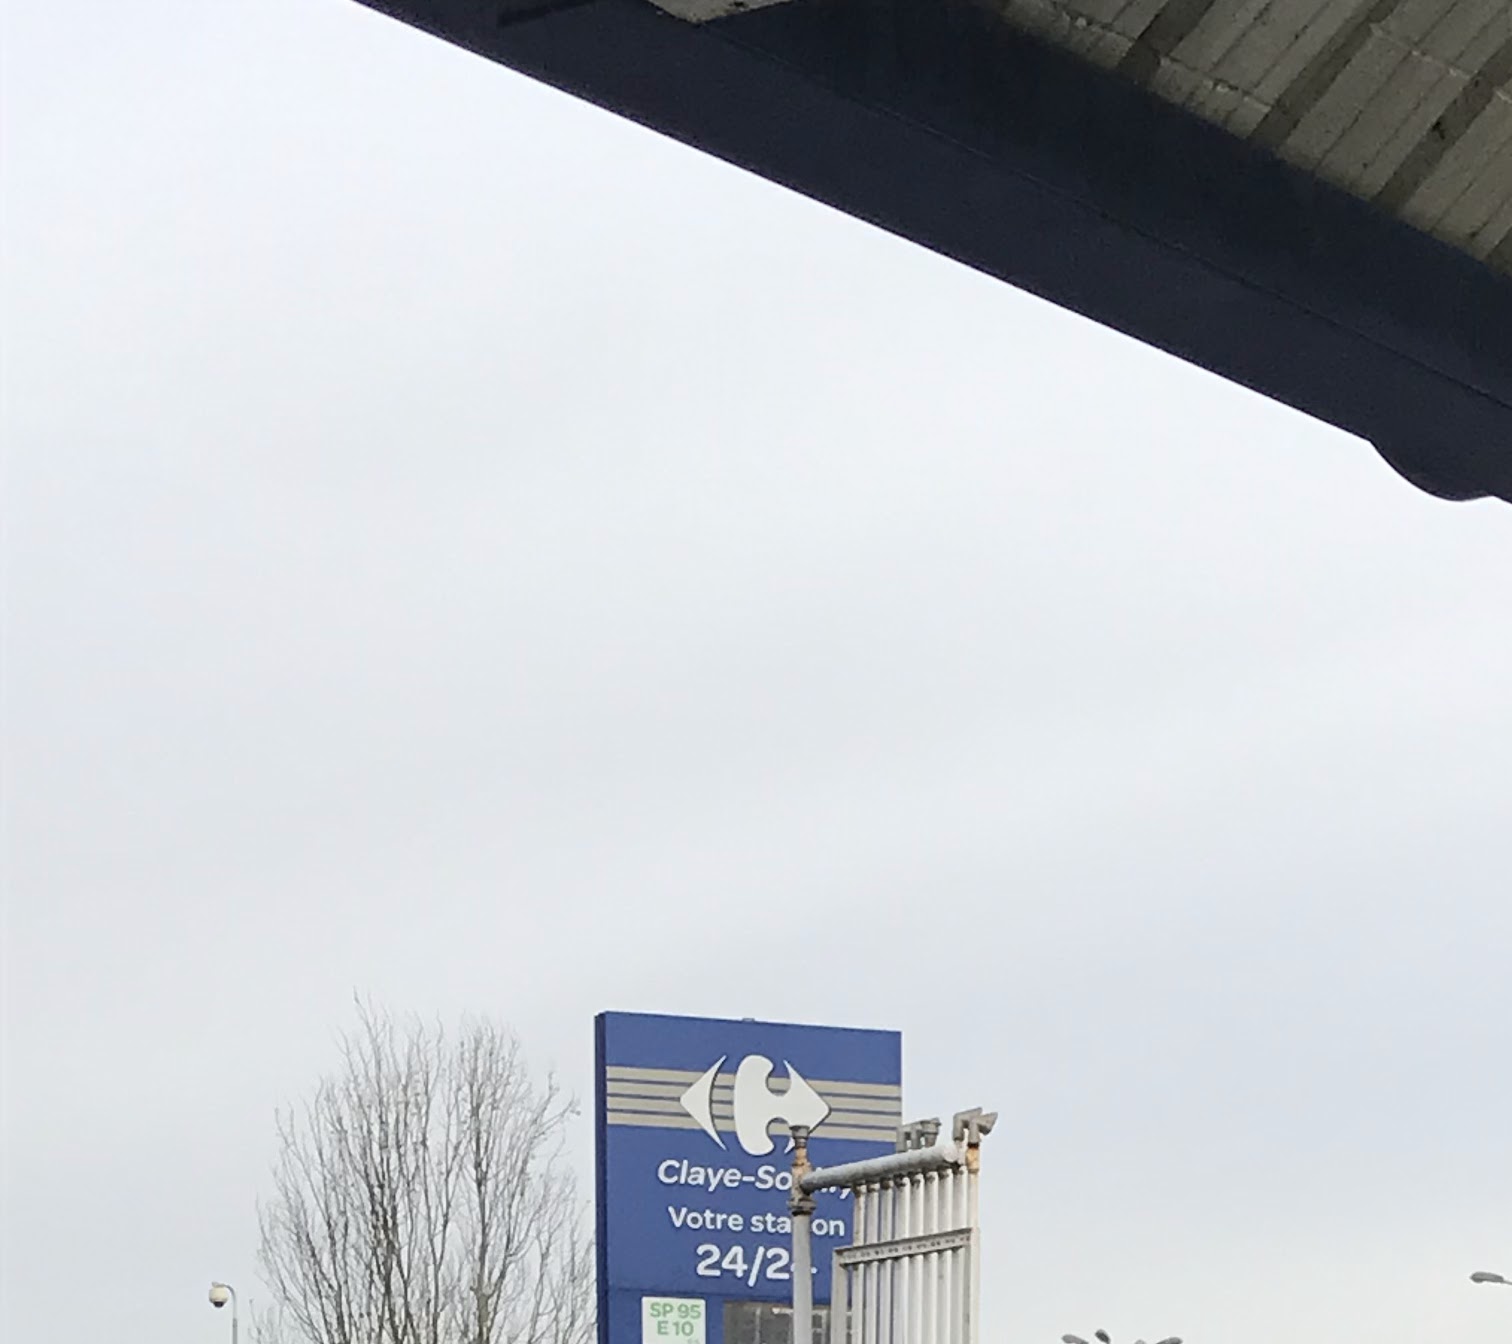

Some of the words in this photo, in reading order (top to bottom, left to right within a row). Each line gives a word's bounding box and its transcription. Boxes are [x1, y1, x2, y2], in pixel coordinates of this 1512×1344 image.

[657, 1159, 851, 1200] Claye-So
[667, 1206, 744, 1231] Votre
[750, 1213, 845, 1236] staon
[696, 1244, 818, 1287] 24/2
[650, 1302, 673, 1318] SP
[678, 1303, 701, 1319] 95
[657, 1321, 668, 1336] E
[673, 1321, 694, 1336] 10
